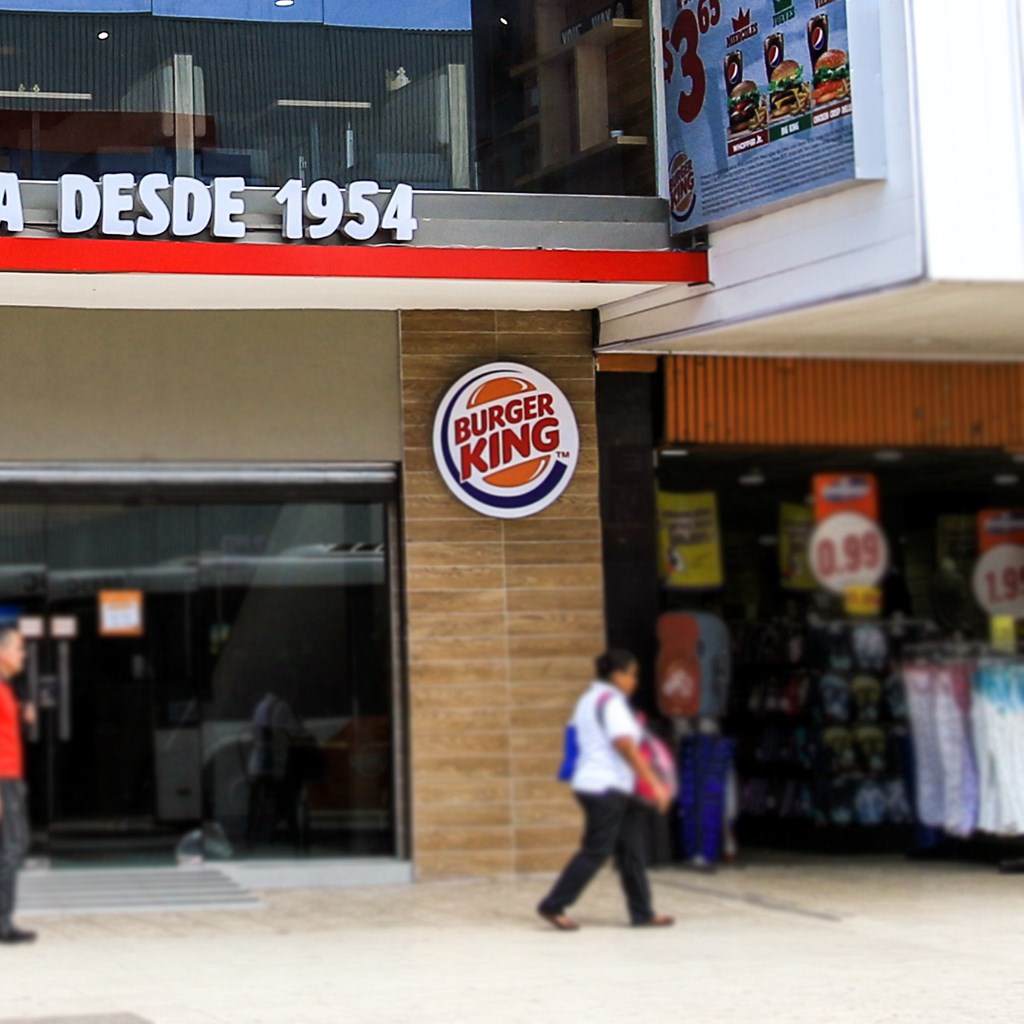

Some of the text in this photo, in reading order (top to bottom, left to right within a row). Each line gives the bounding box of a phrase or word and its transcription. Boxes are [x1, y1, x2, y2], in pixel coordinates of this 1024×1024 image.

[57, 172, 246, 239] DESDE
[275, 178, 418, 242] 1954
[454, 392, 555, 446] BURGER
[460, 417, 560, 481] KING
[816, 531, 882, 577] 0.99
